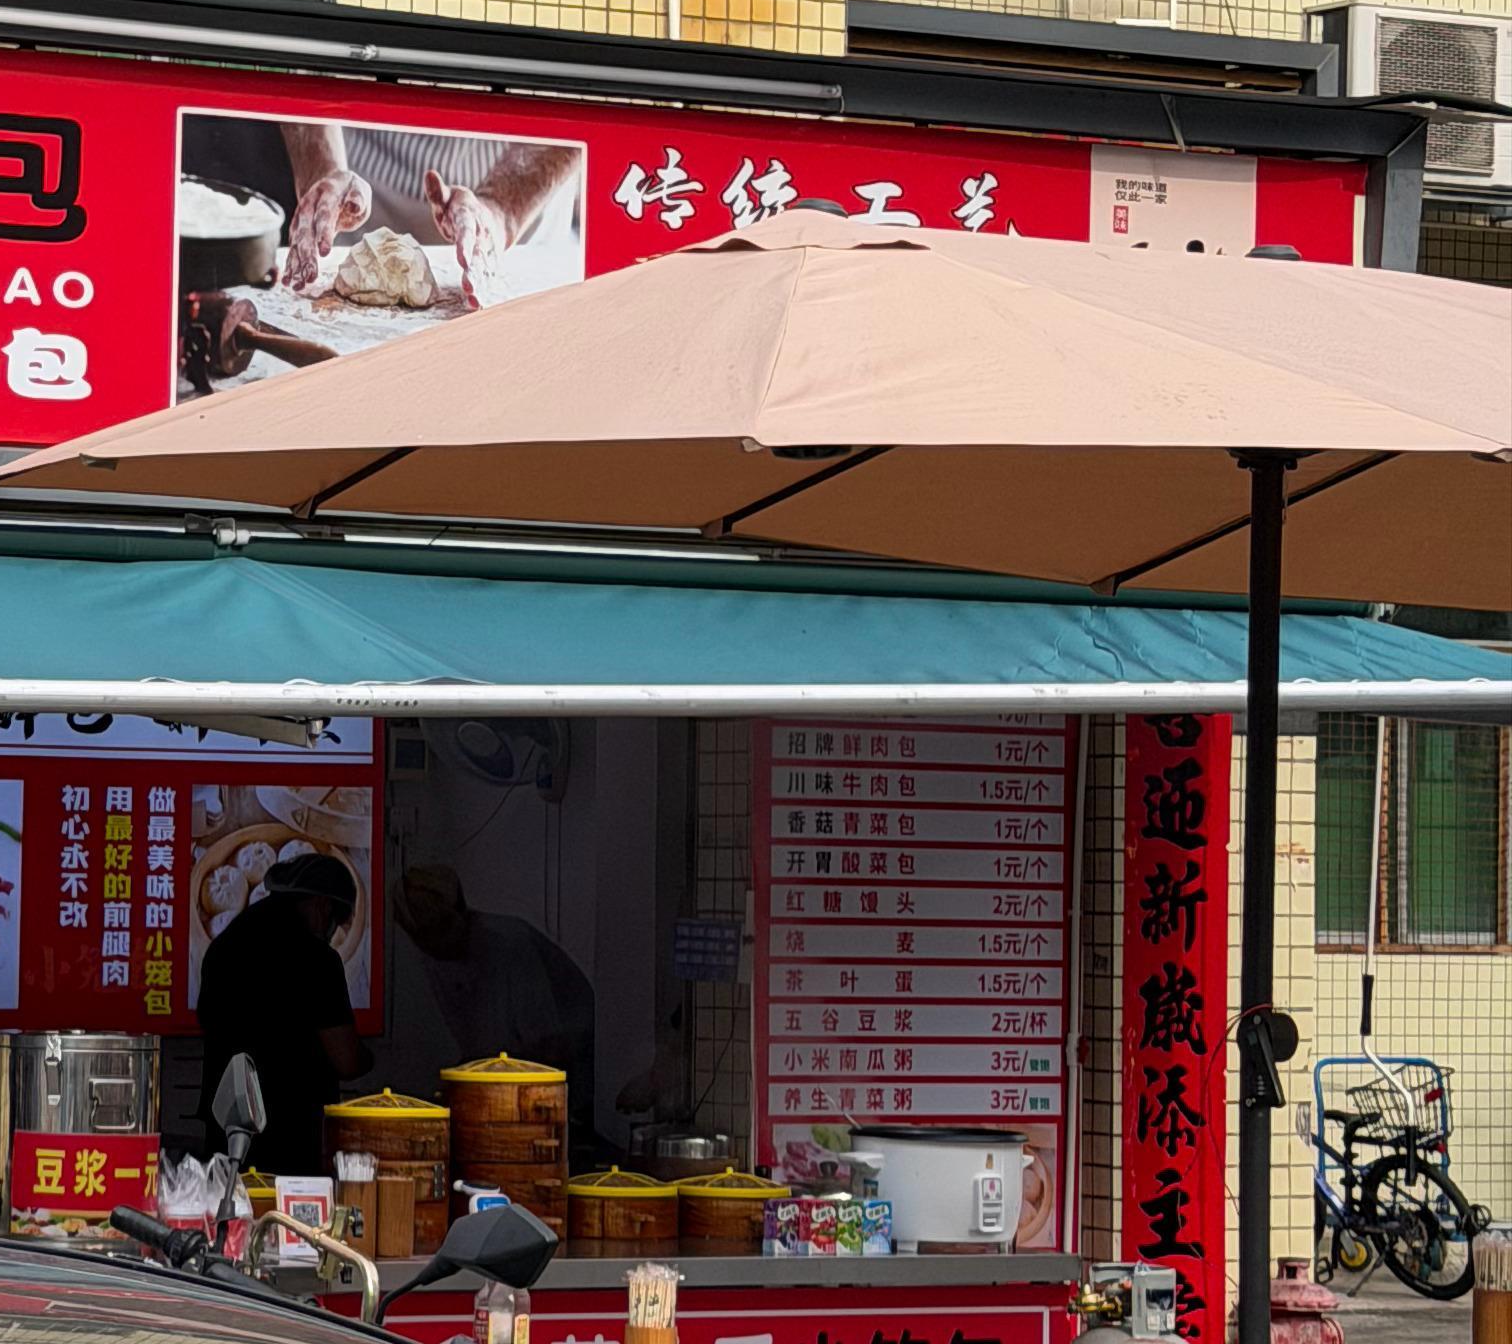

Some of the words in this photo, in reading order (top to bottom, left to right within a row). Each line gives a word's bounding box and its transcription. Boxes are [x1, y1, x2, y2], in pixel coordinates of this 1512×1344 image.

[787, 731, 917, 759] 招牌鲜肉包
[994, 741, 1050, 765] 1元/个
[787, 770, 917, 798] 川味牛肉包
[979, 780, 1050, 803] 1.5元/个
[787, 810, 916, 837] 香菇青菜包
[994, 818, 1049, 842] 1元/个
[59, 785, 90, 928] 初心永不改
[787, 850, 916, 876] 开胃酸菜包
[993, 857, 1048, 881] 1元/个
[101, 785, 134, 987] 用最好的前腿肉
[143, 785, 176, 1016] 做最美味的小笼包
[786, 890, 916, 915] 红糖馒头
[992, 896, 1048, 920] 2元/个
[978, 934, 1049, 956] 1.5元/个
[785, 969, 914, 994] 茶叶蛋
[978, 972, 1048, 996] 1.5元/个
[785, 1008, 913, 1033] 五谷豆浆
[991, 1010, 1048, 1035] 2元/杯
[784, 1047, 913, 1073] 小米南瓜粥
[784, 1087, 913, 1112] 养生青菜粥
